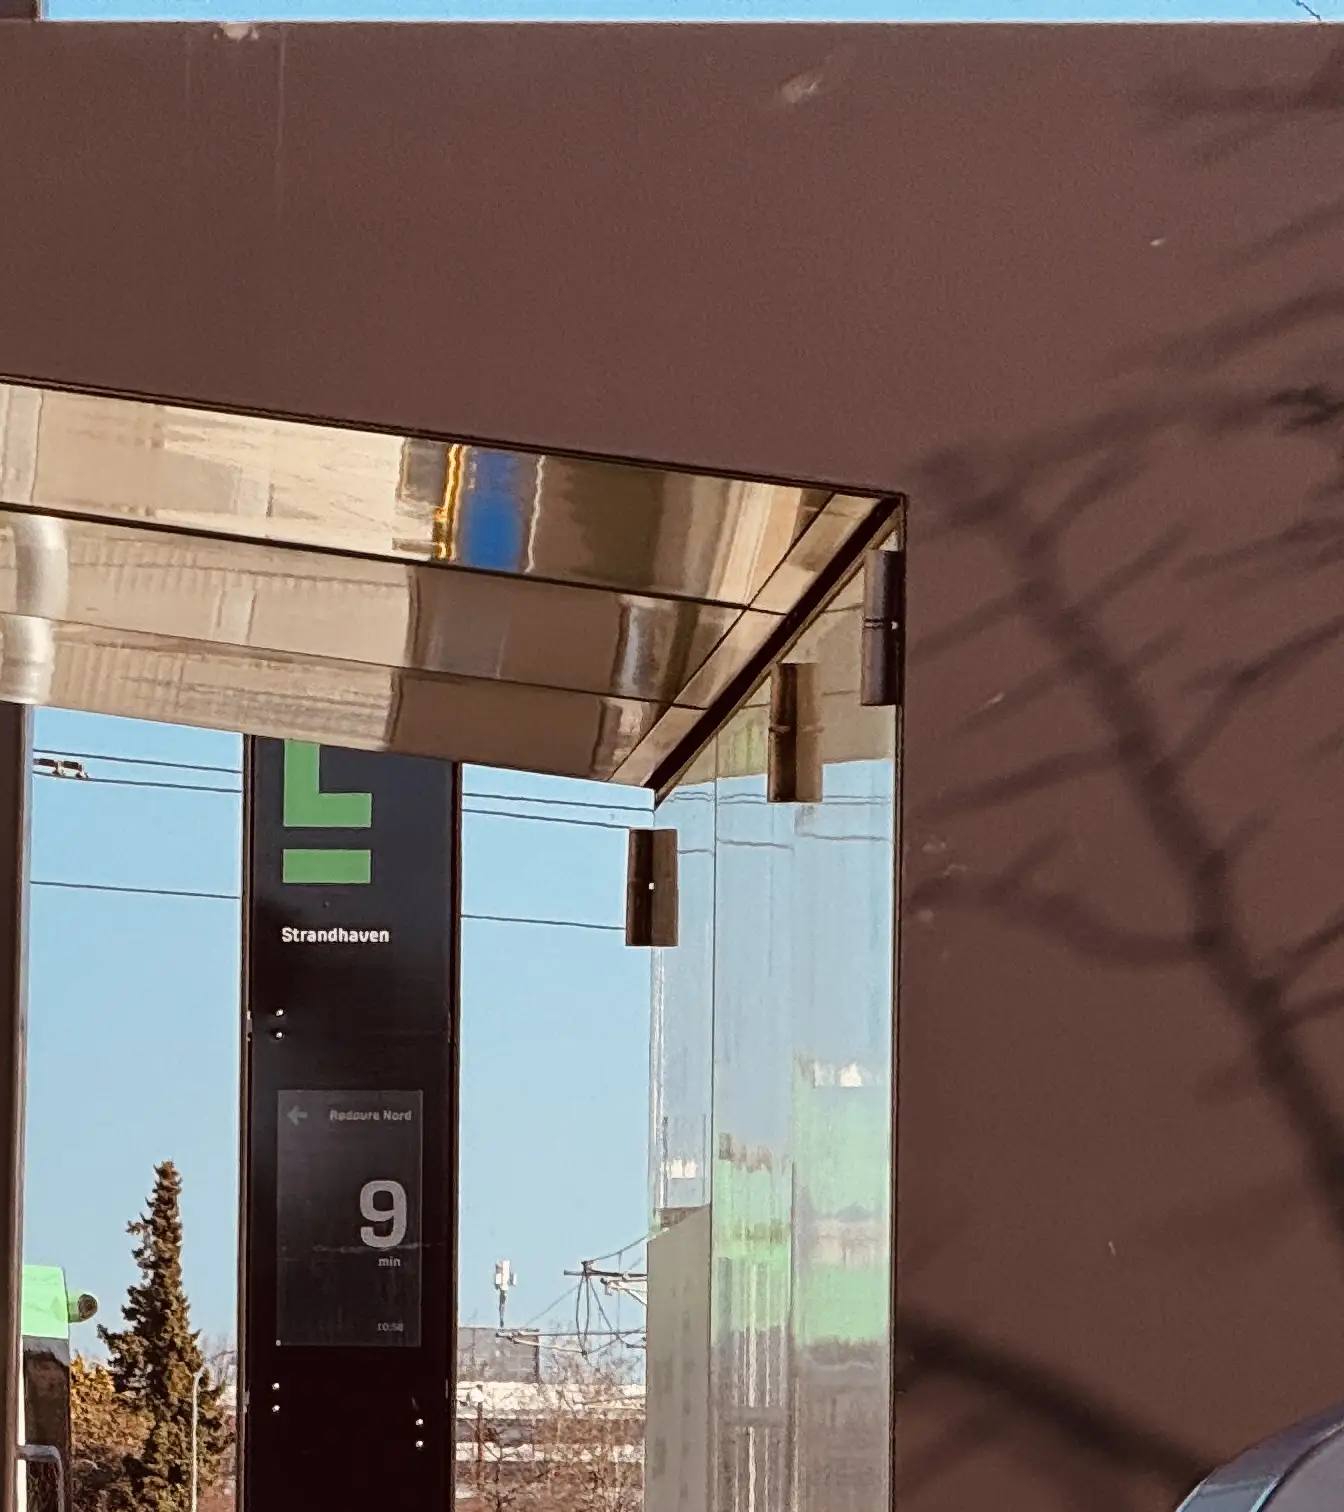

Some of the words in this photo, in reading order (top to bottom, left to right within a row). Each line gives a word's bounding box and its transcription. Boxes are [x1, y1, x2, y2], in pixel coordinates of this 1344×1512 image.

[281, 927, 389, 943] Strandhaven
[383, 1108, 412, 1121] Nord
[360, 1180, 407, 1248] 9
[378, 1255, 401, 1267] min
